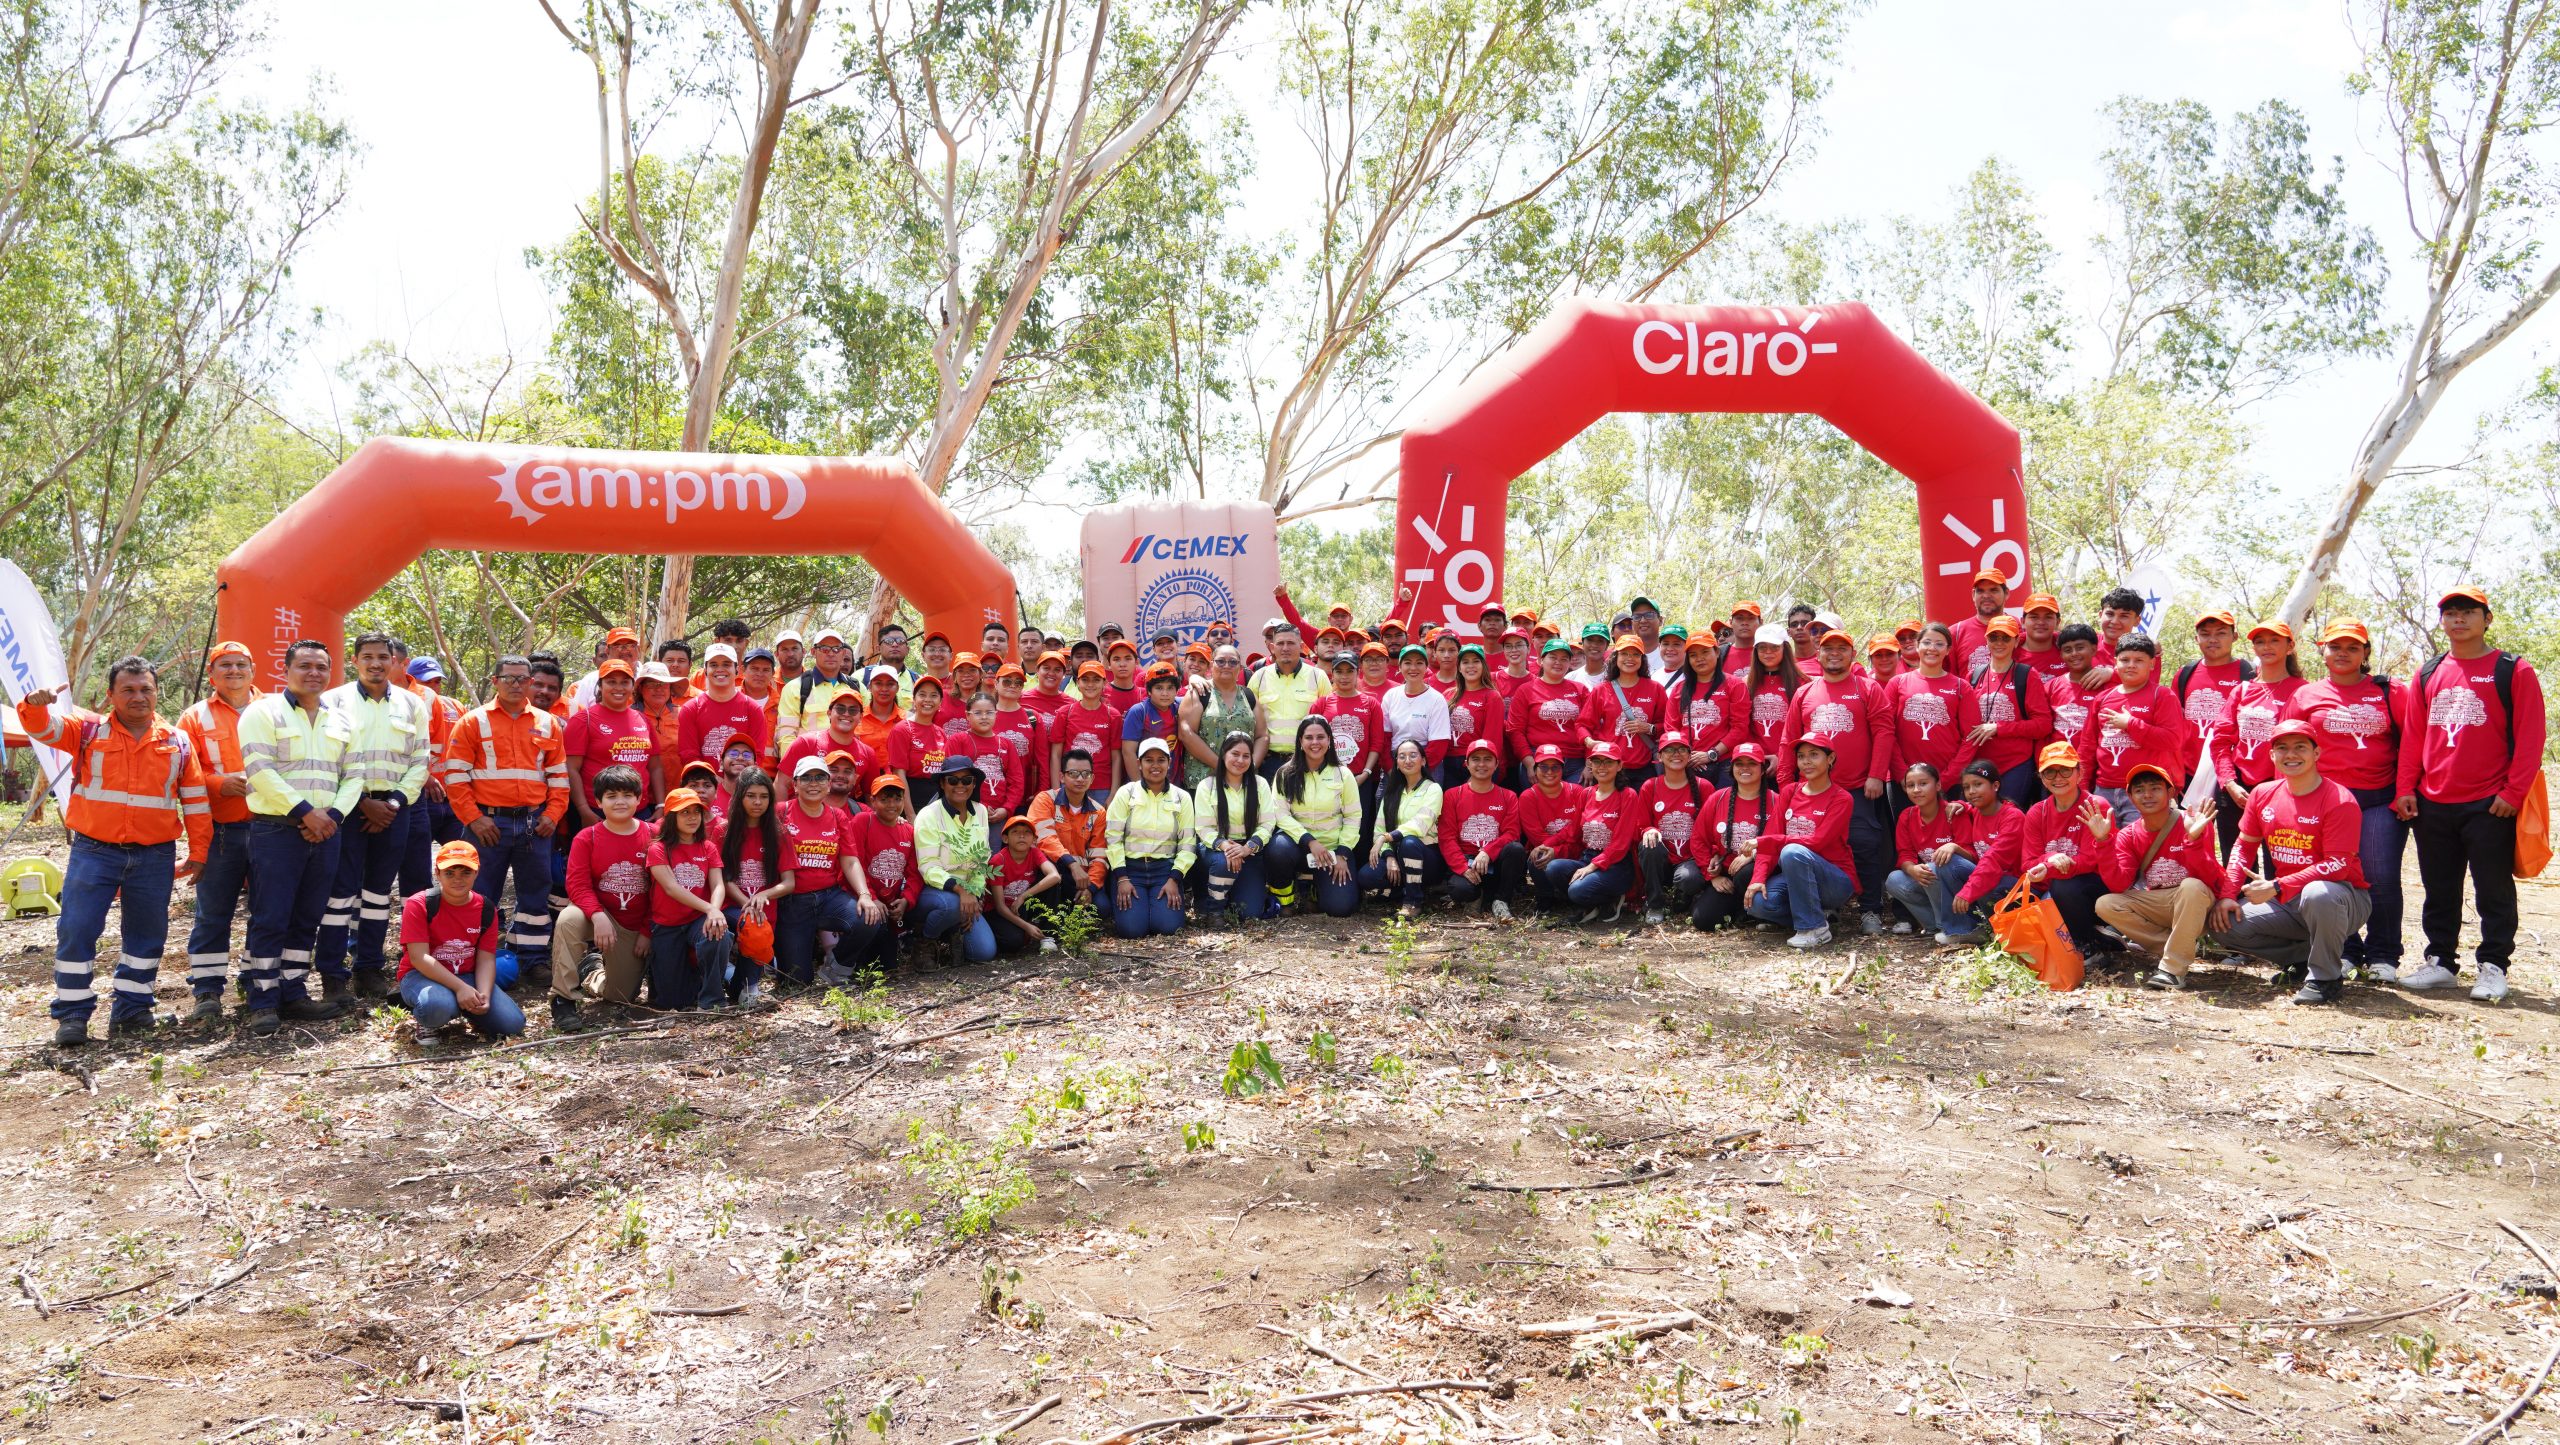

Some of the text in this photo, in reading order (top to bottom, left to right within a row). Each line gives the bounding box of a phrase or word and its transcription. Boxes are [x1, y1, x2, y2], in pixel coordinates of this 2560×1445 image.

[1152, 533, 1250, 561] CEMEX
[1145, 580, 1227, 634] CEMENTO PORTLAN
[2470, 675, 2492, 683] Claro
[2330, 721, 2371, 729] Reforestá
[612, 754, 649, 762] CAMBIOS
[2298, 816, 2316, 824] Claro
[798, 858, 833, 869] AMBIOS
